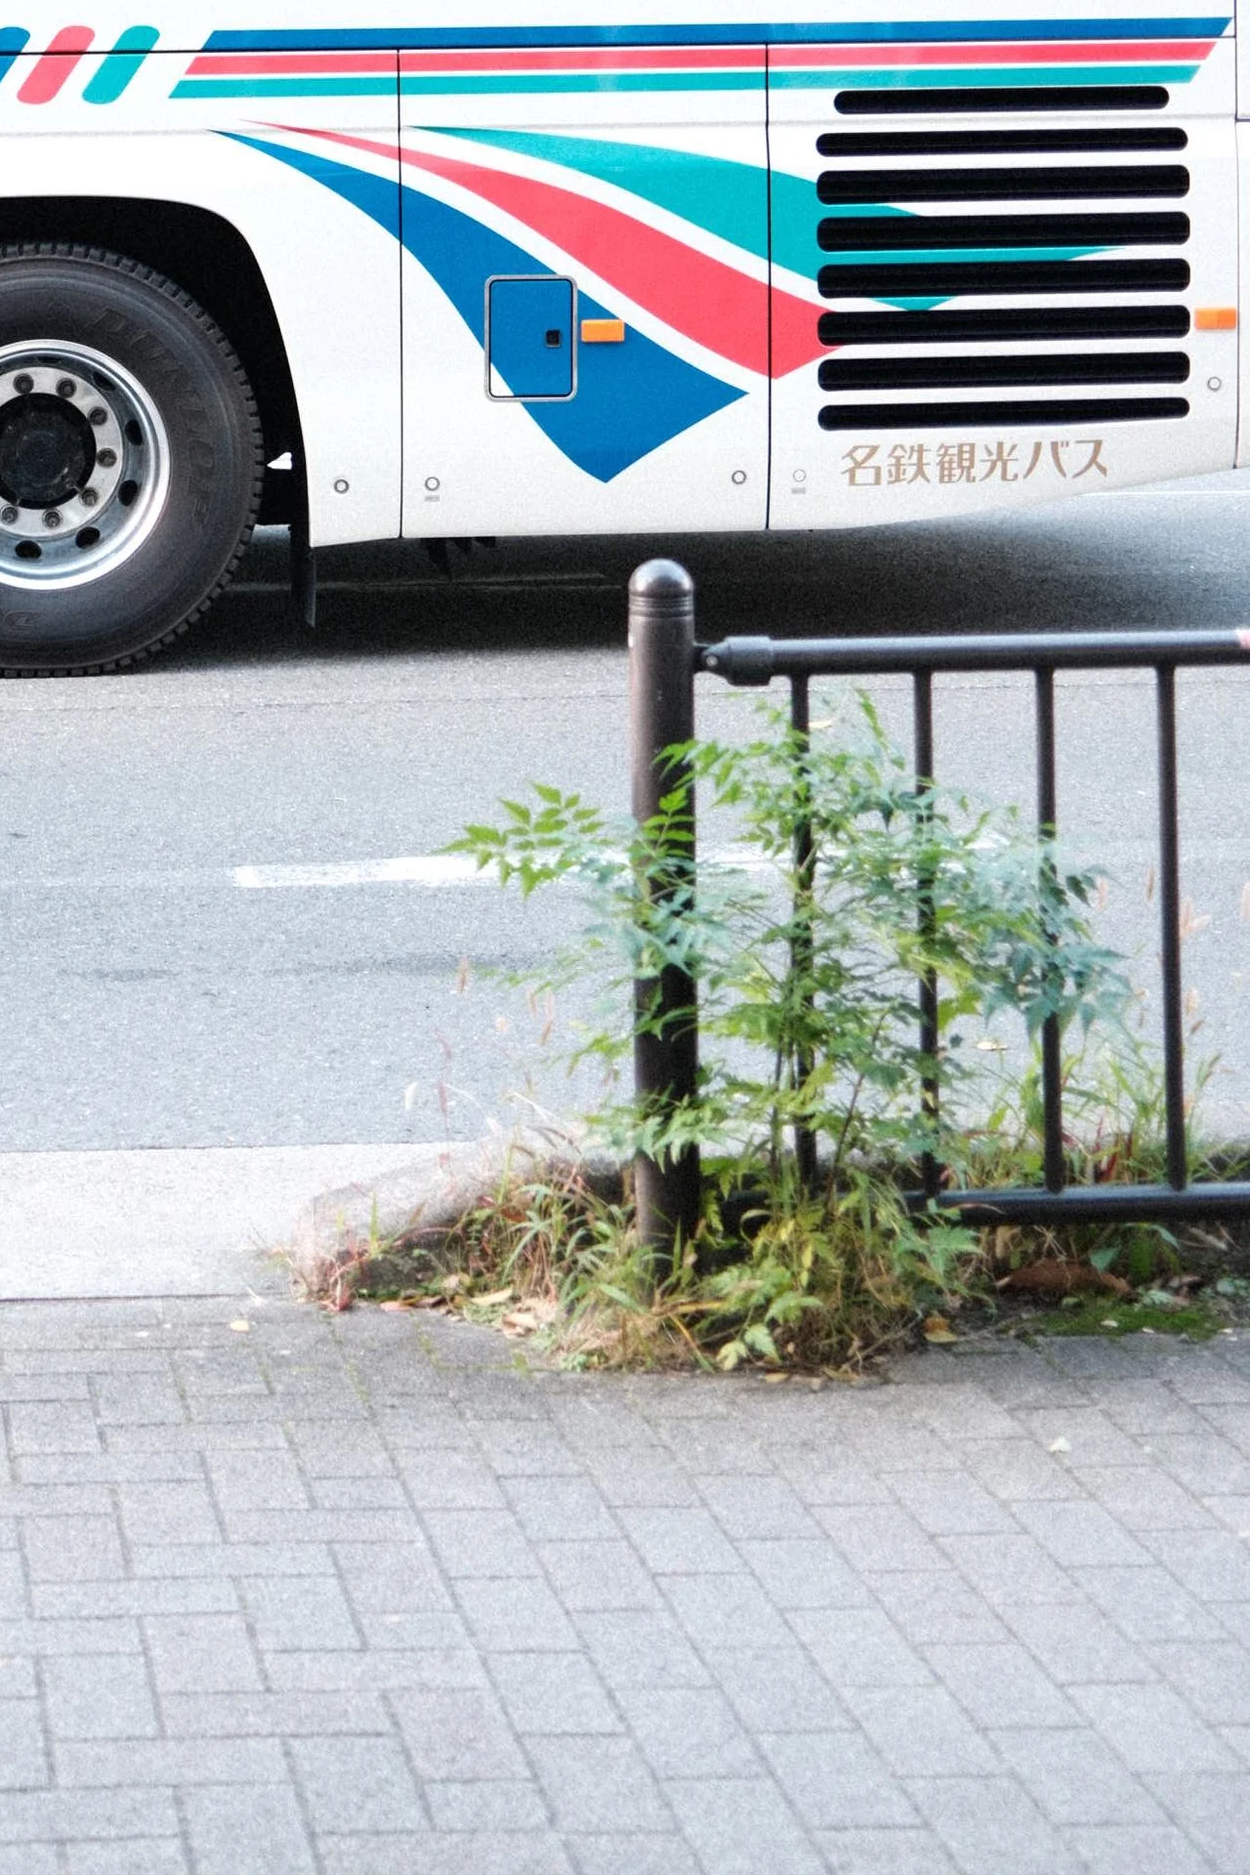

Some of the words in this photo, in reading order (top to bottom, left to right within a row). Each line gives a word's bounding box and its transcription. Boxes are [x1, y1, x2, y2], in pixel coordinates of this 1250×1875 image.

[841, 439, 1107, 486] 名鉄観光バス
